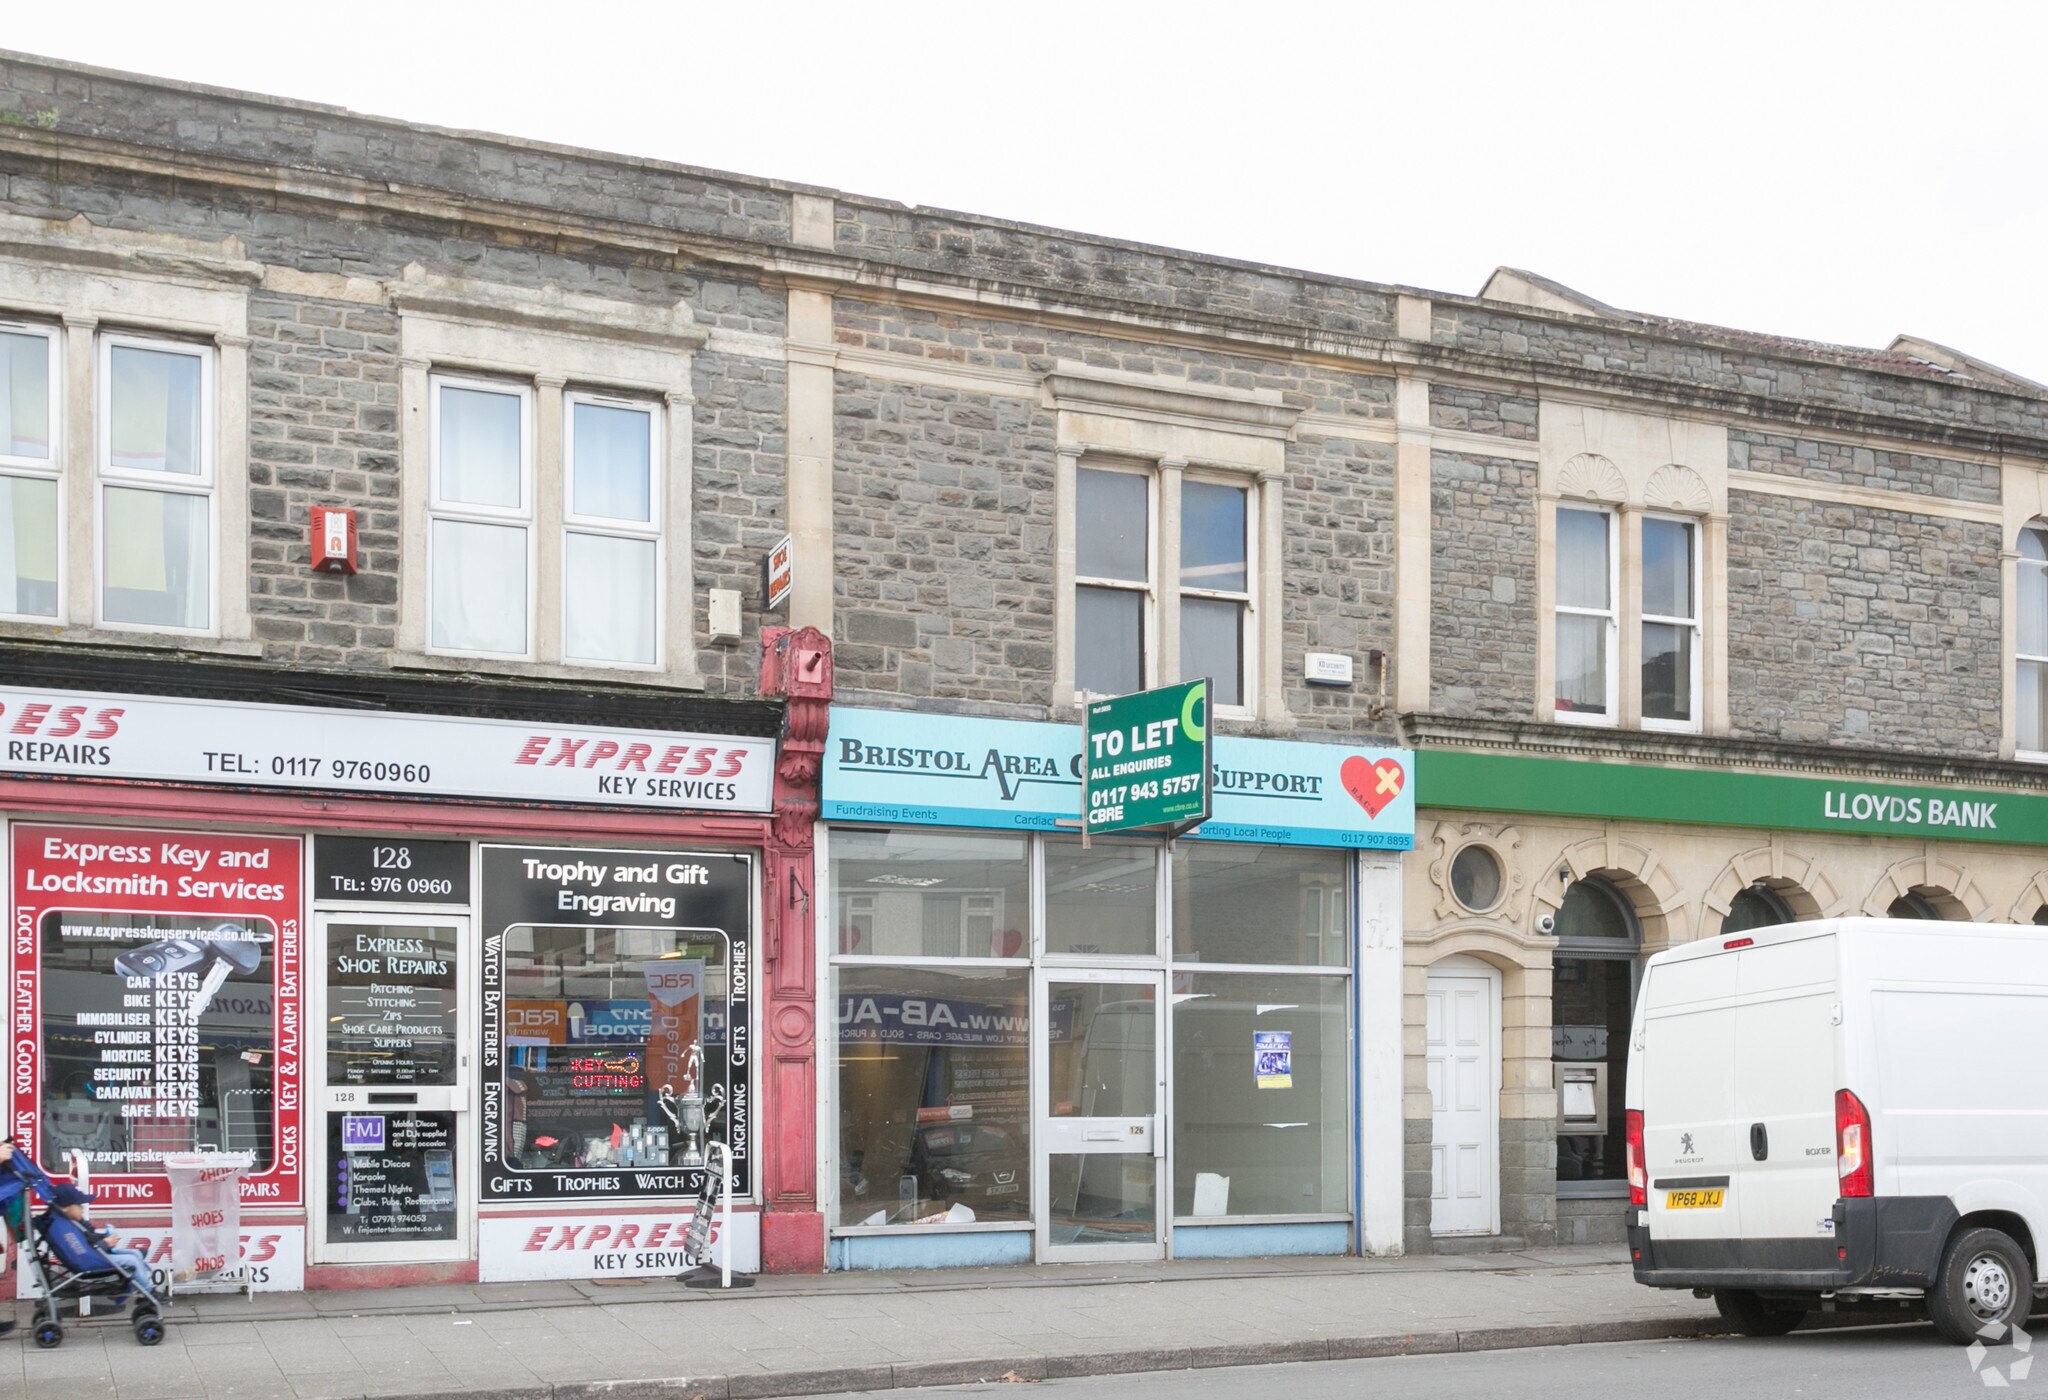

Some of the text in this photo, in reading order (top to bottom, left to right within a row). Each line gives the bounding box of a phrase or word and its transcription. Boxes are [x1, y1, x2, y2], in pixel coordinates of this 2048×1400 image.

[0, 702, 126, 740] ESS
[1091, 718, 1178, 759] TO LET
[8, 740, 111, 766] REPAIRS
[513, 736, 748, 777] EXPRESS
[203, 752, 431, 784] TEL: 0117 9760960
[839, 738, 970, 771] BRISTOL
[980, 749, 1060, 800] AREA
[1091, 766, 1111, 780] ALL
[1113, 755, 1172, 776] ENQUIRIES
[598, 775, 736, 801] KEY SERVICES
[1091, 773, 1200, 808] 0117 943 5757
[836, 804, 938, 820] Fundraising Events
[1088, 805, 1124, 824] CBRE
[1824, 790, 1998, 829] LLOYDS BANK
[1014, 814, 1053, 827] Cardiac
[1199, 826, 1292, 840] porting Local People
[1341, 834, 1410, 846] 0117 907 8895
[44, 837, 270, 872] Express Key and
[372, 846, 412, 870] 128
[522, 858, 709, 887] Trophy and Gift
[26, 869, 285, 901] Locksmith Services
[331, 876, 452, 895] TEL: 976 0960
[558, 890, 676, 918] Engraving
[61, 924, 256, 943] www.expresskeyservices.co.uk
[356, 934, 424, 954] EXPRESS
[337, 956, 448, 975] SHOE REPAIRS
[127, 972, 199, 990] CAR KEYS
[370, 983, 414, 994] PATCHING
[124, 990, 199, 1008] BIKE KEYS
[366, 996, 416, 1008] STITCHING
[77, 1008, 199, 1026] IMMOBILISER KEYS
[382, 1010, 402, 1021] ZIPS
[16, 906, 36, 1160] LOCKS LEATHER GOODS SLIPPE
[94, 1027, 199, 1044] CYLINDER KEYS
[342, 1024, 443, 1035] SHOE CARE PRODUCTS
[280, 918, 297, 1175] LOCKS KEY & ALARM BATTERIES
[374, 1038, 412, 1048] SLIPPERS
[484, 934, 501, 1163] WATCH BATTERIES ENGRAVING
[731, 940, 746, 1160] ENGRAVING GIFTS TROPHIES
[101, 1046, 199, 1063] MORTICE KEYS
[94, 1064, 199, 1082] SECURITY KEYS
[574, 1058, 604, 1072] KEY
[572, 1074, 640, 1088] CUTTING
[96, 1082, 199, 1100] CARAVAN KEYS
[335, 1093, 355, 1102] 128
[121, 1100, 199, 1118] SAFE KEYS
[346, 1122, 381, 1138] FMJ
[392, 1120, 438, 1128] Mobile Discos
[1130, 1126, 1144, 1134] 126
[392, 1130, 404, 1138] and
[422, 1130, 447, 1139] supplied
[392, 1140, 403, 1148] for
[1805, 1148, 1831, 1156] BOXER
[353, 1160, 410, 1168] Mobile Discos
[353, 1172, 386, 1182] Karaoke
[490, 1176, 532, 1192] GIFTS
[552, 1174, 620, 1192] TROPHIES
[635, 1173, 684, 1190] WATCH
[89, 1184, 154, 1198] UTTING
[238, 1182, 280, 1197] PAIRS
[354, 1184, 412, 1194] Themed Nights
[404, 1196, 449, 1205] Restaurants
[1672, 1192, 1697, 1206] YP68
[1699, 1192, 1720, 1206] JXJ
[192, 1209, 224, 1227] SHOES
[372, 1215, 396, 1223] 07976
[397, 1214, 426, 1222] 974053
[358, 1224, 443, 1235] fmjentertainments.co.uk
[594, 1252, 713, 1270] KEY SERVICE
